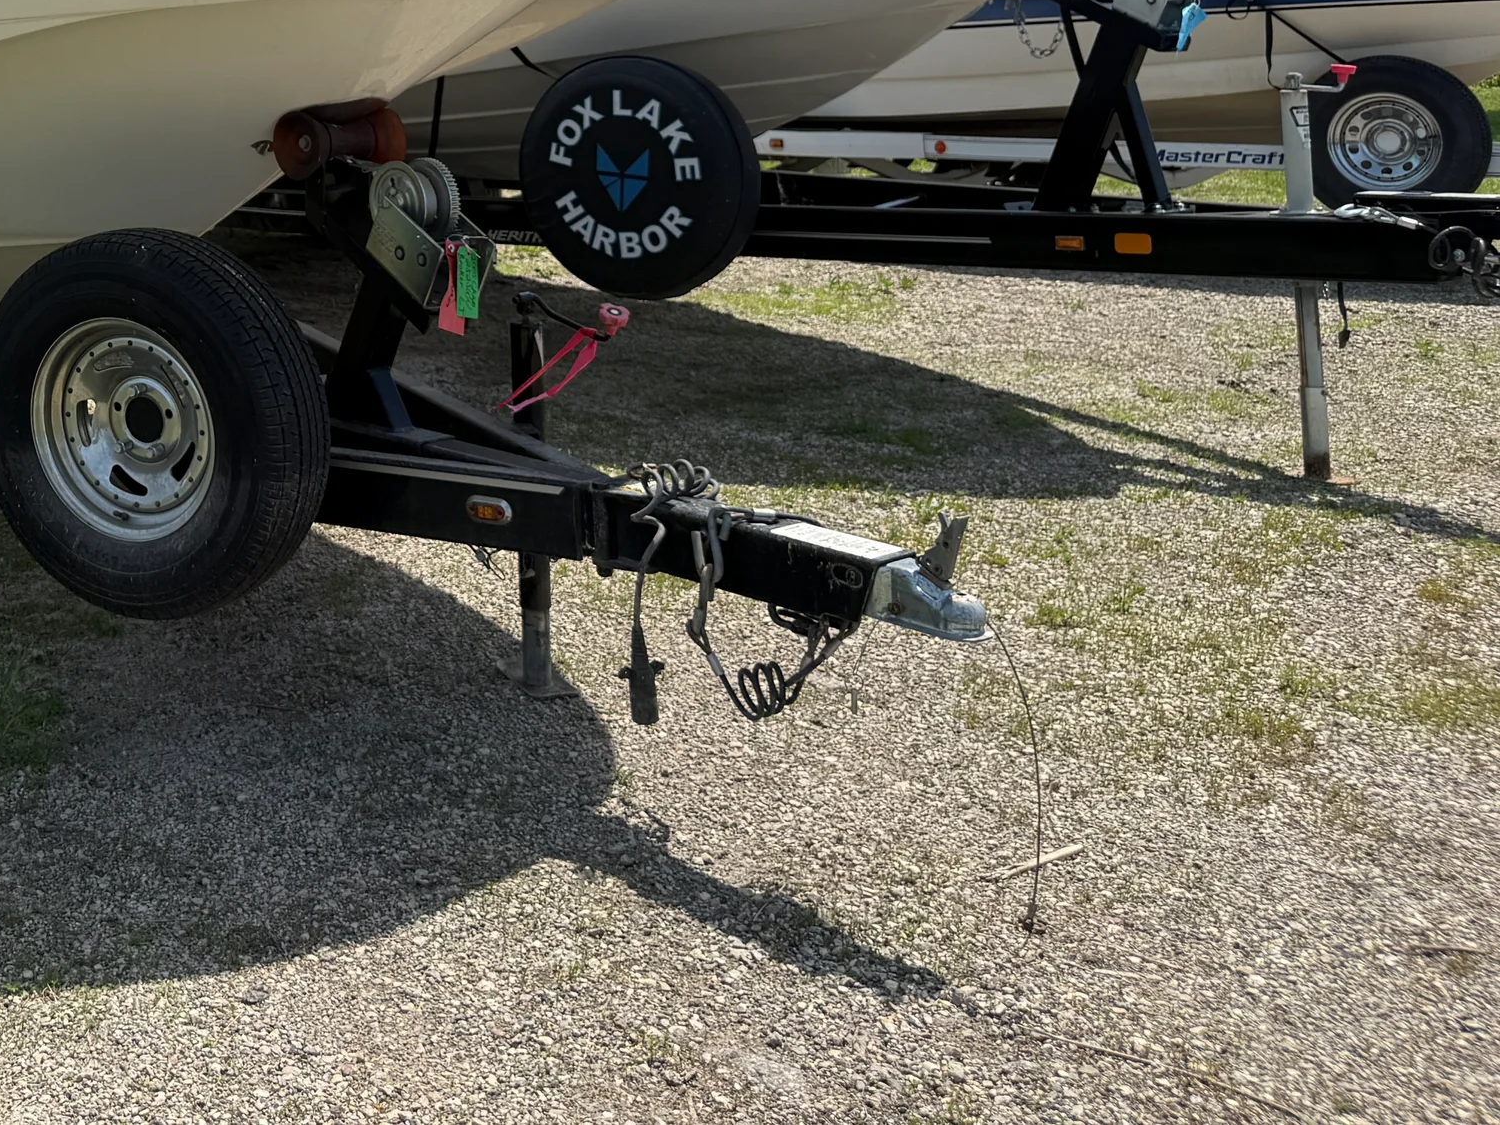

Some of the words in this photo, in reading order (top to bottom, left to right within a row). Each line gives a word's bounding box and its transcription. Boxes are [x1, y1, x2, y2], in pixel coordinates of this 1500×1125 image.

[549, 95, 604, 167] FOX
[612, 89, 702, 182] LAKE
[487, 229, 543, 243] HERITA
[555, 190, 693, 259] HARBOR
